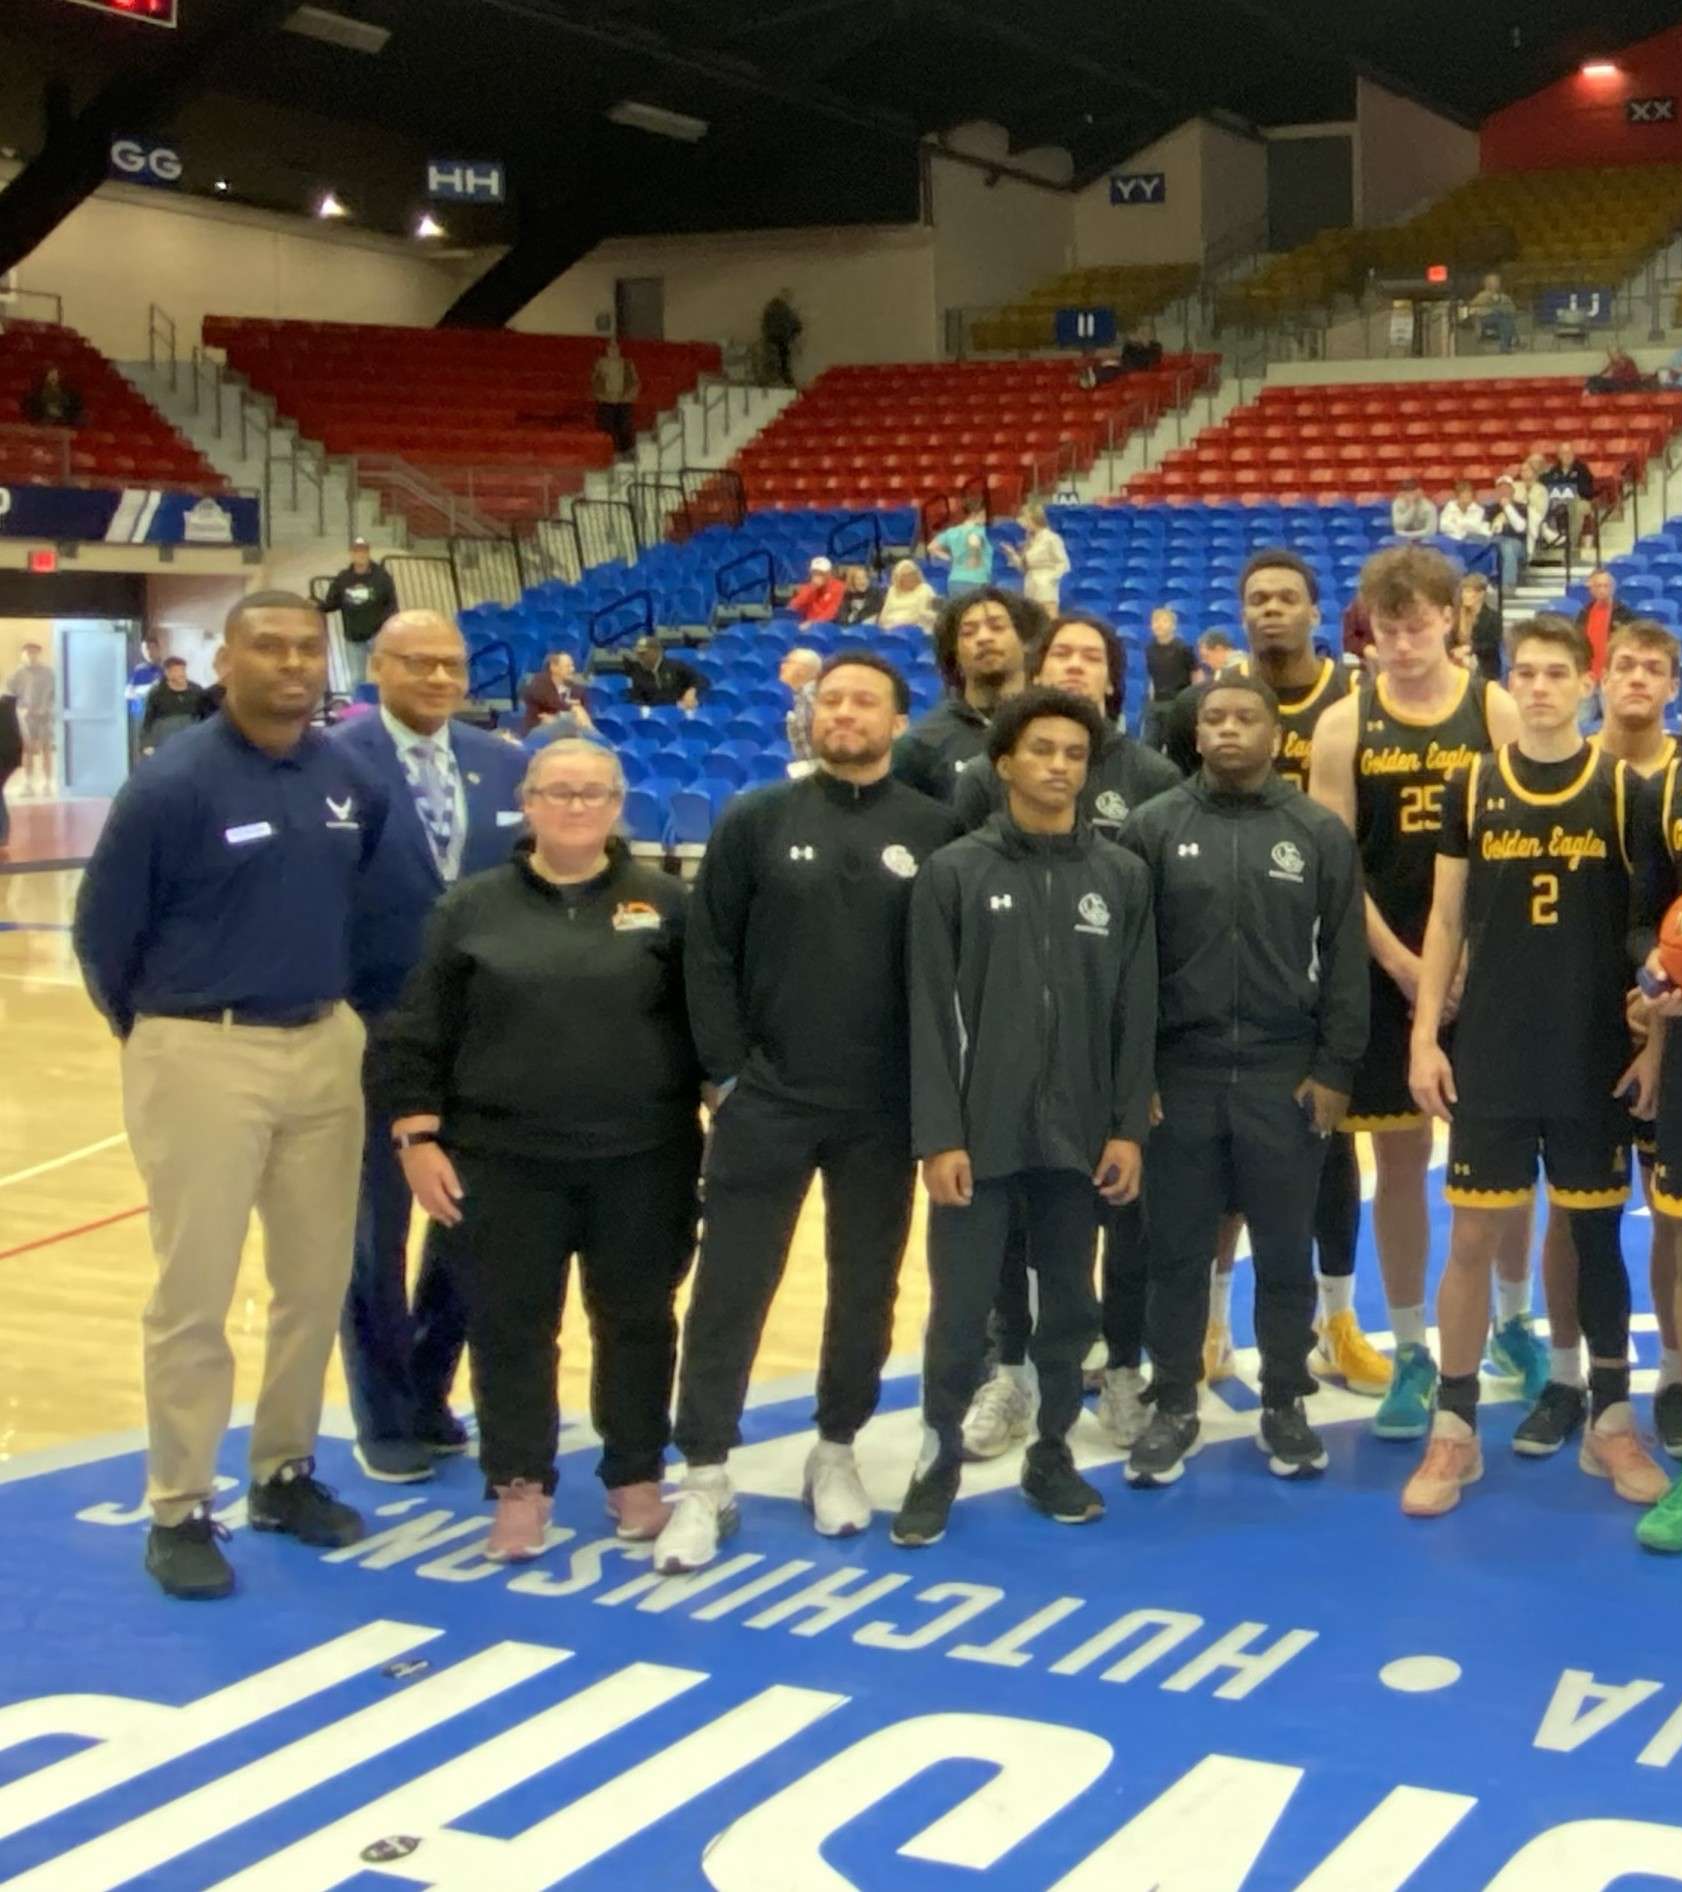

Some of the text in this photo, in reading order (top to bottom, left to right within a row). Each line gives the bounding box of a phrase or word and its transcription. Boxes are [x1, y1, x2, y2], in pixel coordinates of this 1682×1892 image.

[1631, 100, 1674, 122] XX
[110, 139, 183, 180] GG
[428, 165, 500, 196] HH
[1116, 177, 1160, 200] YY
[1549, 487, 1574, 499] AA
[1361, 741, 1473, 782] Golden Eagle
[1401, 784, 1445, 832] 25
[1482, 829, 1544, 861] Golden
[1532, 873, 1559, 926] 2
